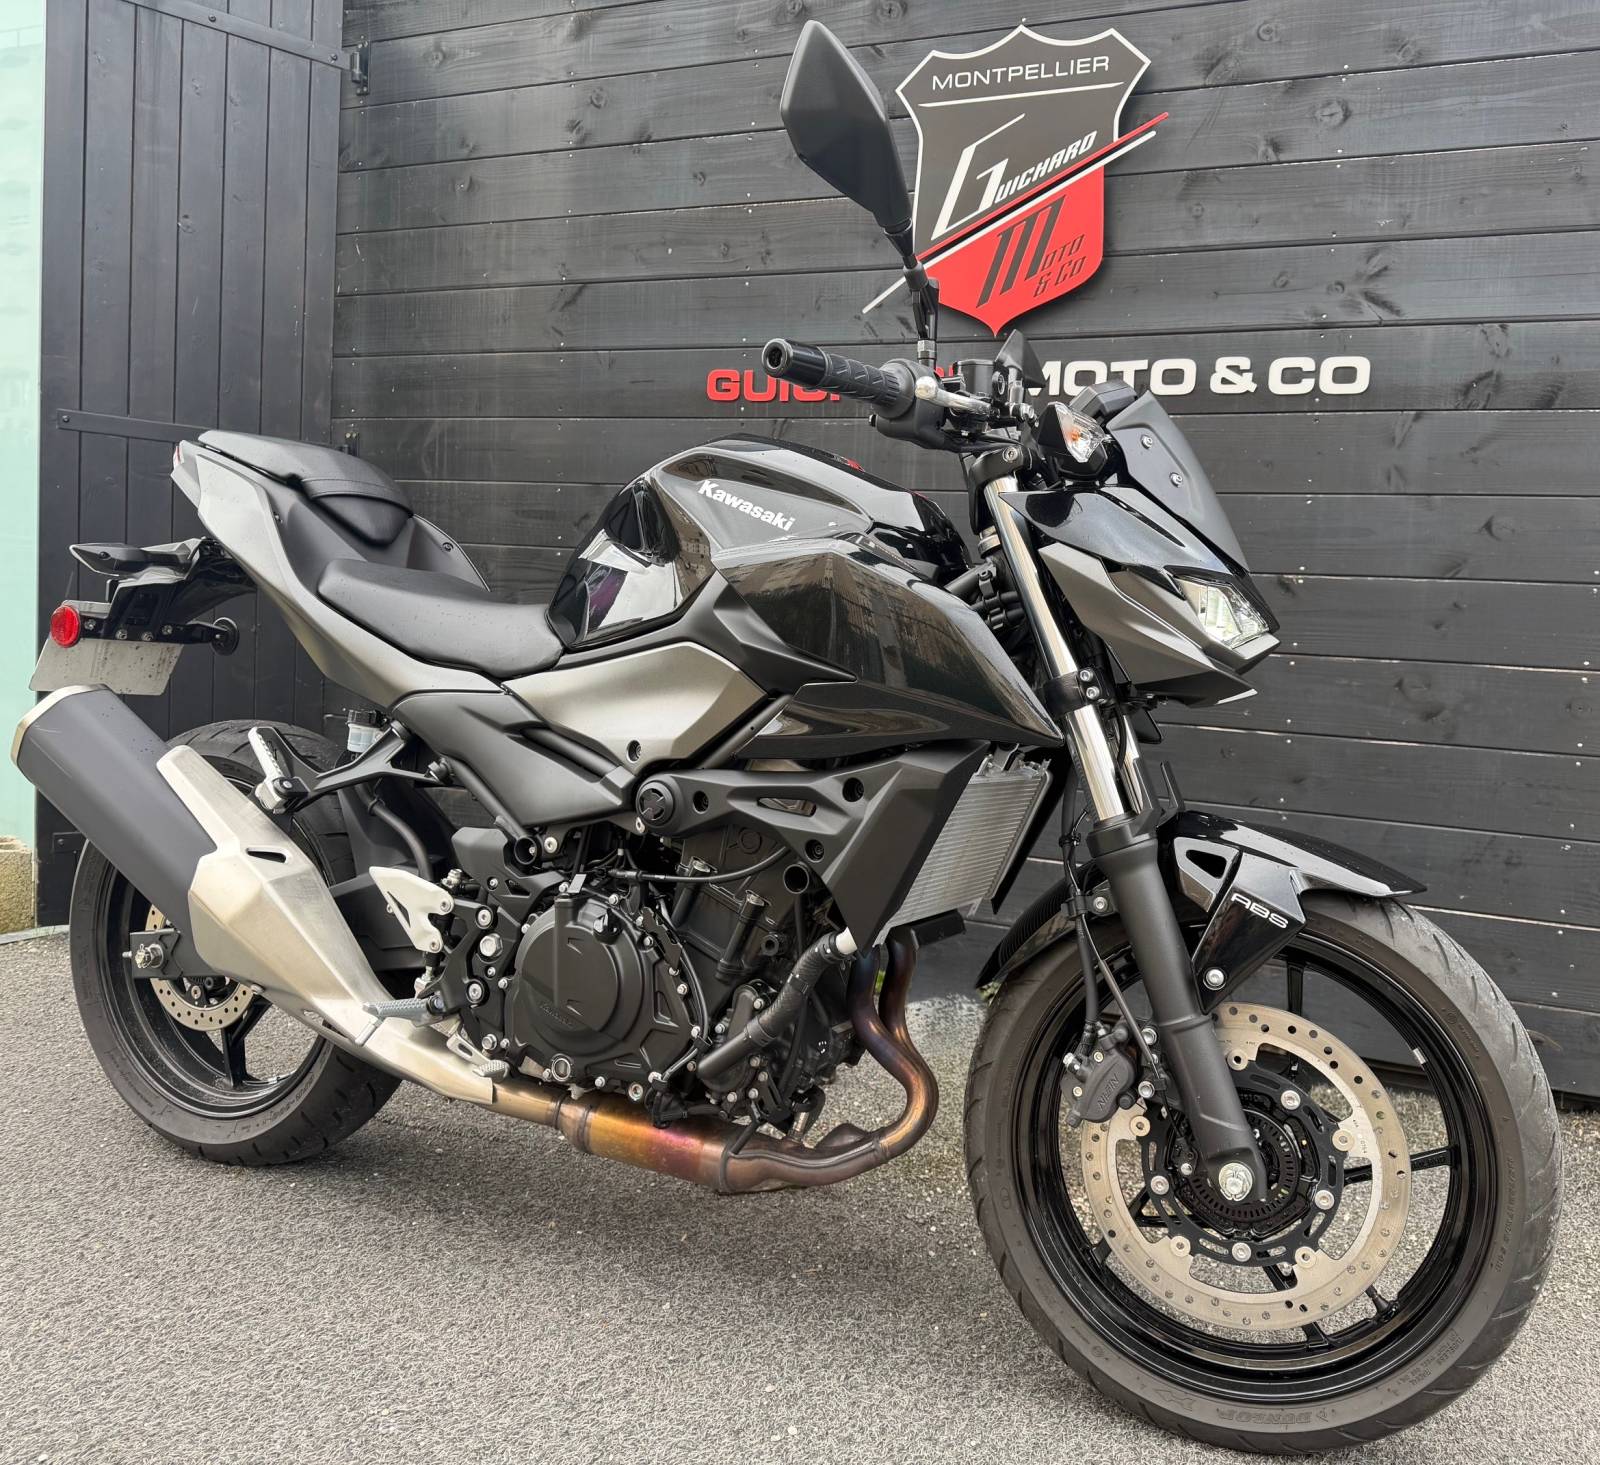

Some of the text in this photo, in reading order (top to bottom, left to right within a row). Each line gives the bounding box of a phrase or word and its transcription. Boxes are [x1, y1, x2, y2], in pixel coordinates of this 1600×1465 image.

[932, 55, 1109, 91] MONTPELLIER
[1055, 255, 1087, 286] CO
[1209, 355, 1258, 395] &
[1268, 356, 1371, 396] CO
[698, 480, 796, 532] Kawasaki
[1231, 892, 1289, 930] ABS
